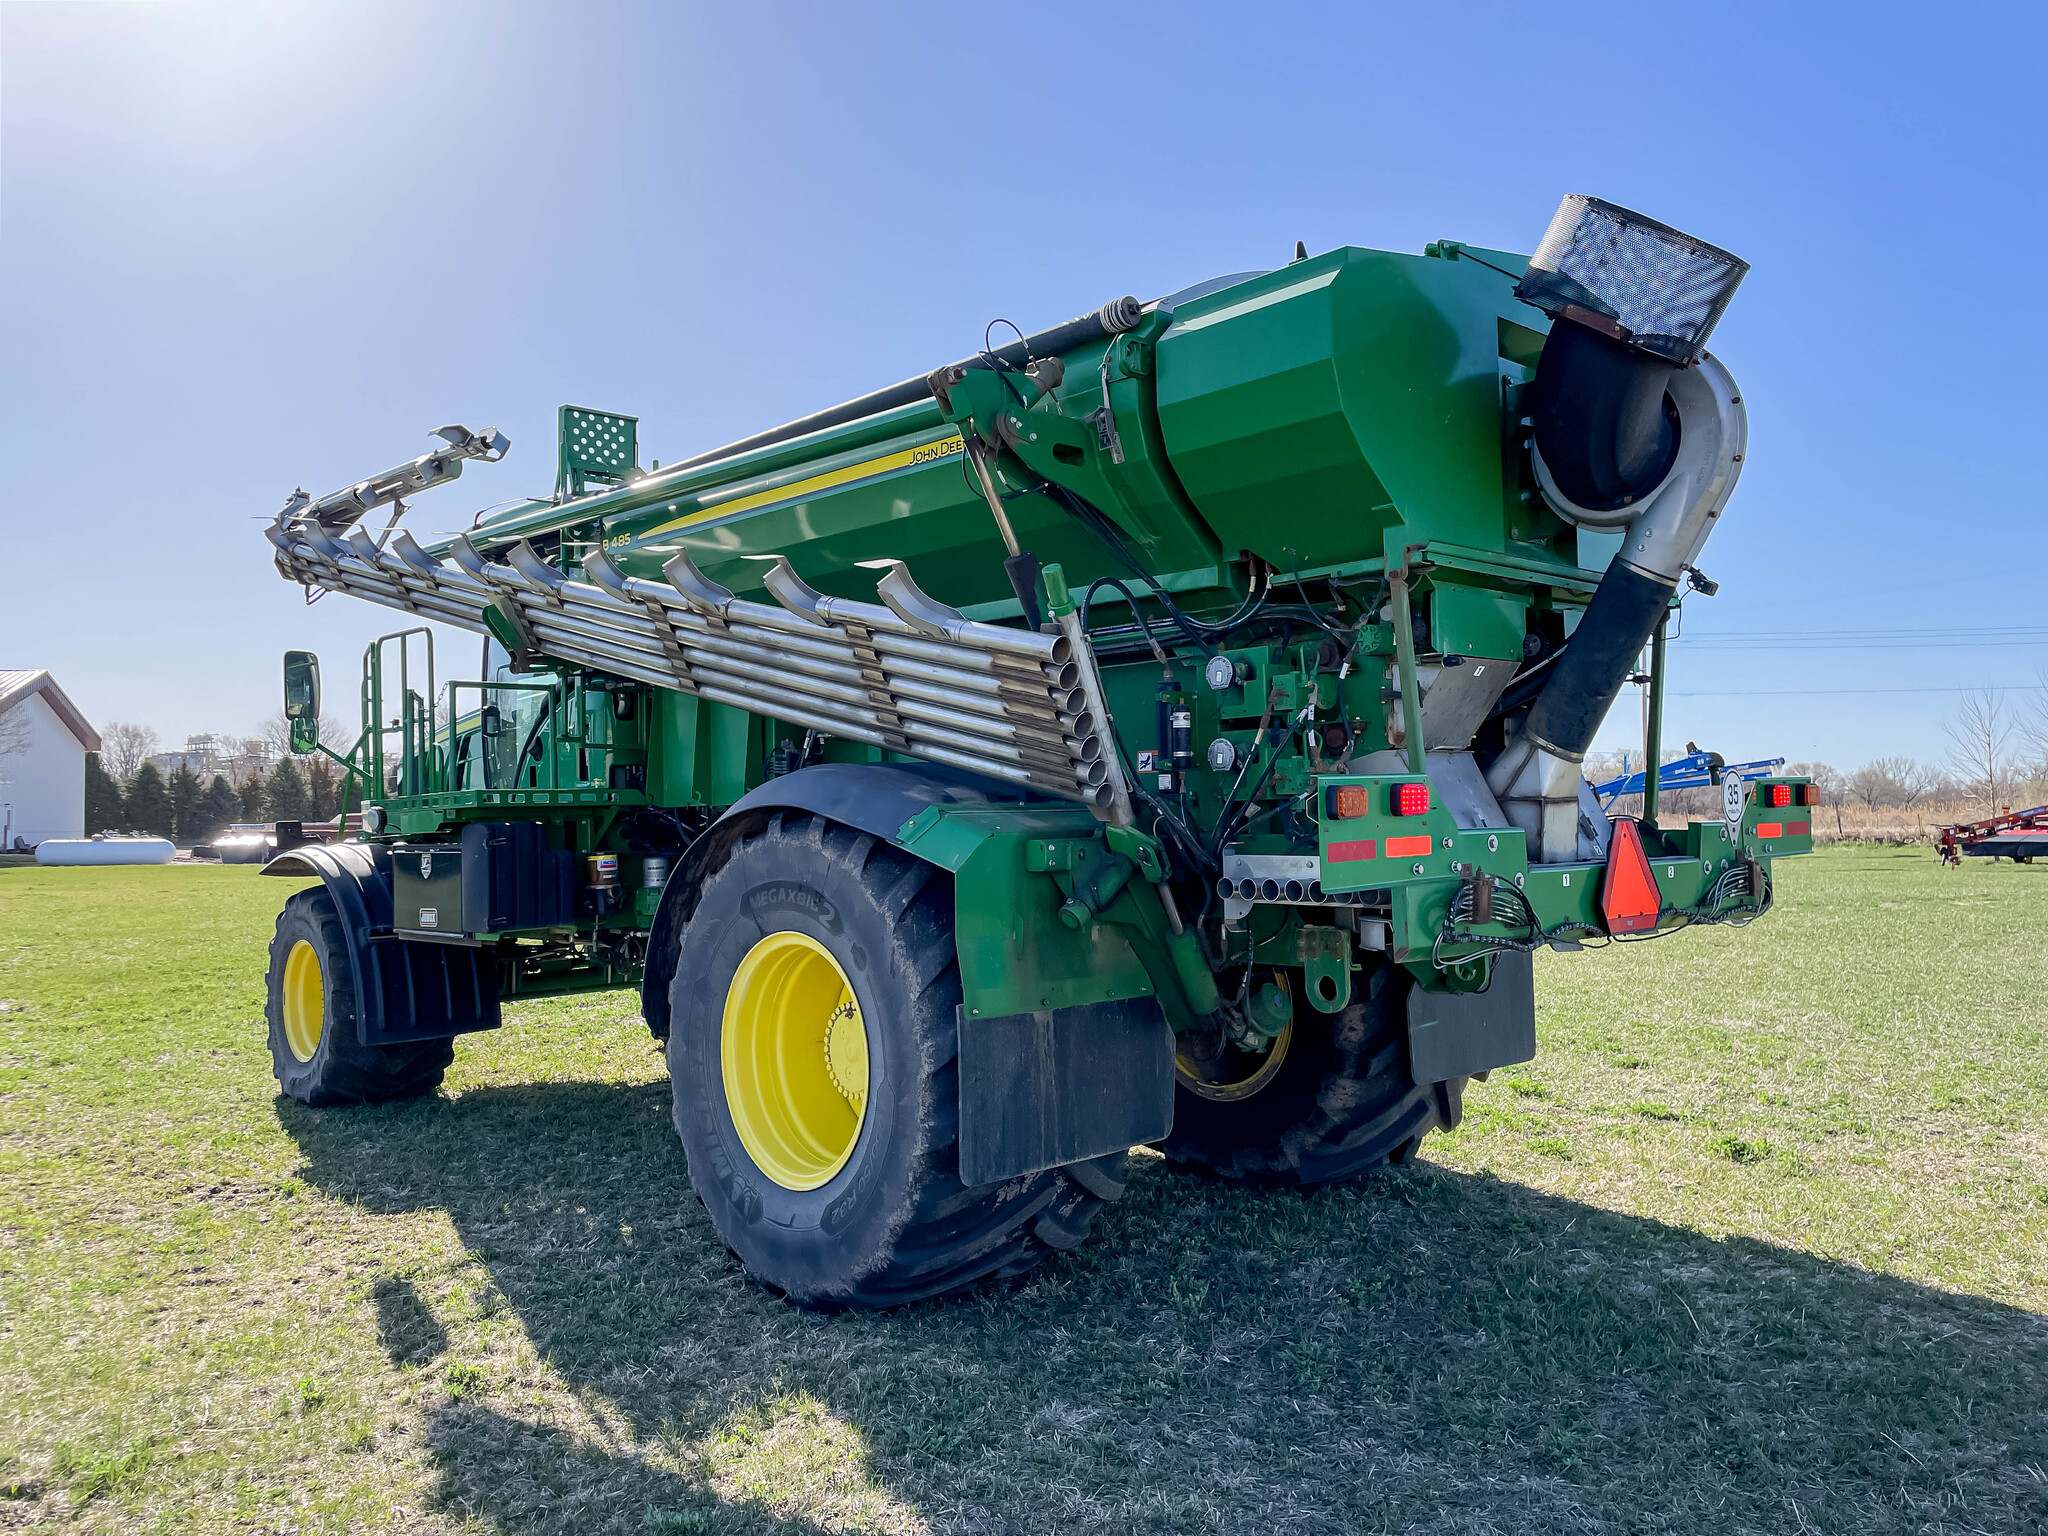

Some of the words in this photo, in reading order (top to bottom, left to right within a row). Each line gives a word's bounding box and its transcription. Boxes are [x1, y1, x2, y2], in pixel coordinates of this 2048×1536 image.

[909, 447, 938, 465] JOHN
[940, 440, 963, 455] DEE
[611, 532, 631, 548] 485
[1727, 783, 1739, 805] 35
[819, 902, 835, 929] 2
